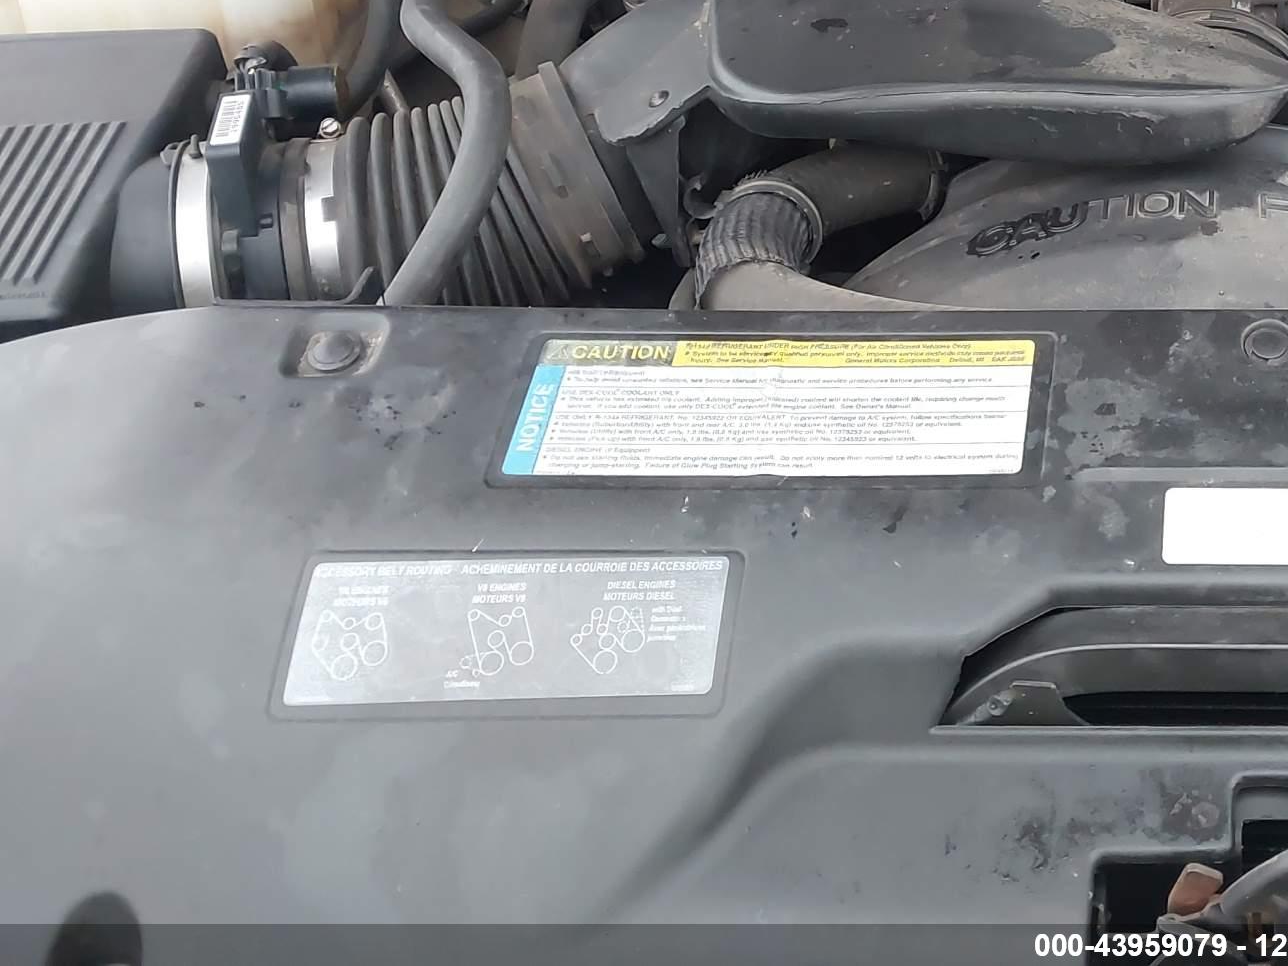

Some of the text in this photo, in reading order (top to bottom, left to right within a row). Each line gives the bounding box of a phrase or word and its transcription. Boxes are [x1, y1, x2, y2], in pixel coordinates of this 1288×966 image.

[968, 189, 1218, 255] CAUTION
[572, 346, 670, 359] CAUTION
[516, 384, 553, 452] NOTICE
[461, 561, 723, 574] ACHEMINEMENT DE LA COURROIE DES ACCESSOIRES
[489, 583, 527, 592] ENGINES
[608, 580, 676, 589] DIESEL ENGINES
[472, 594, 513, 603] MOTEURS
[603, 592, 675, 601] MOTEURS DIESEL
